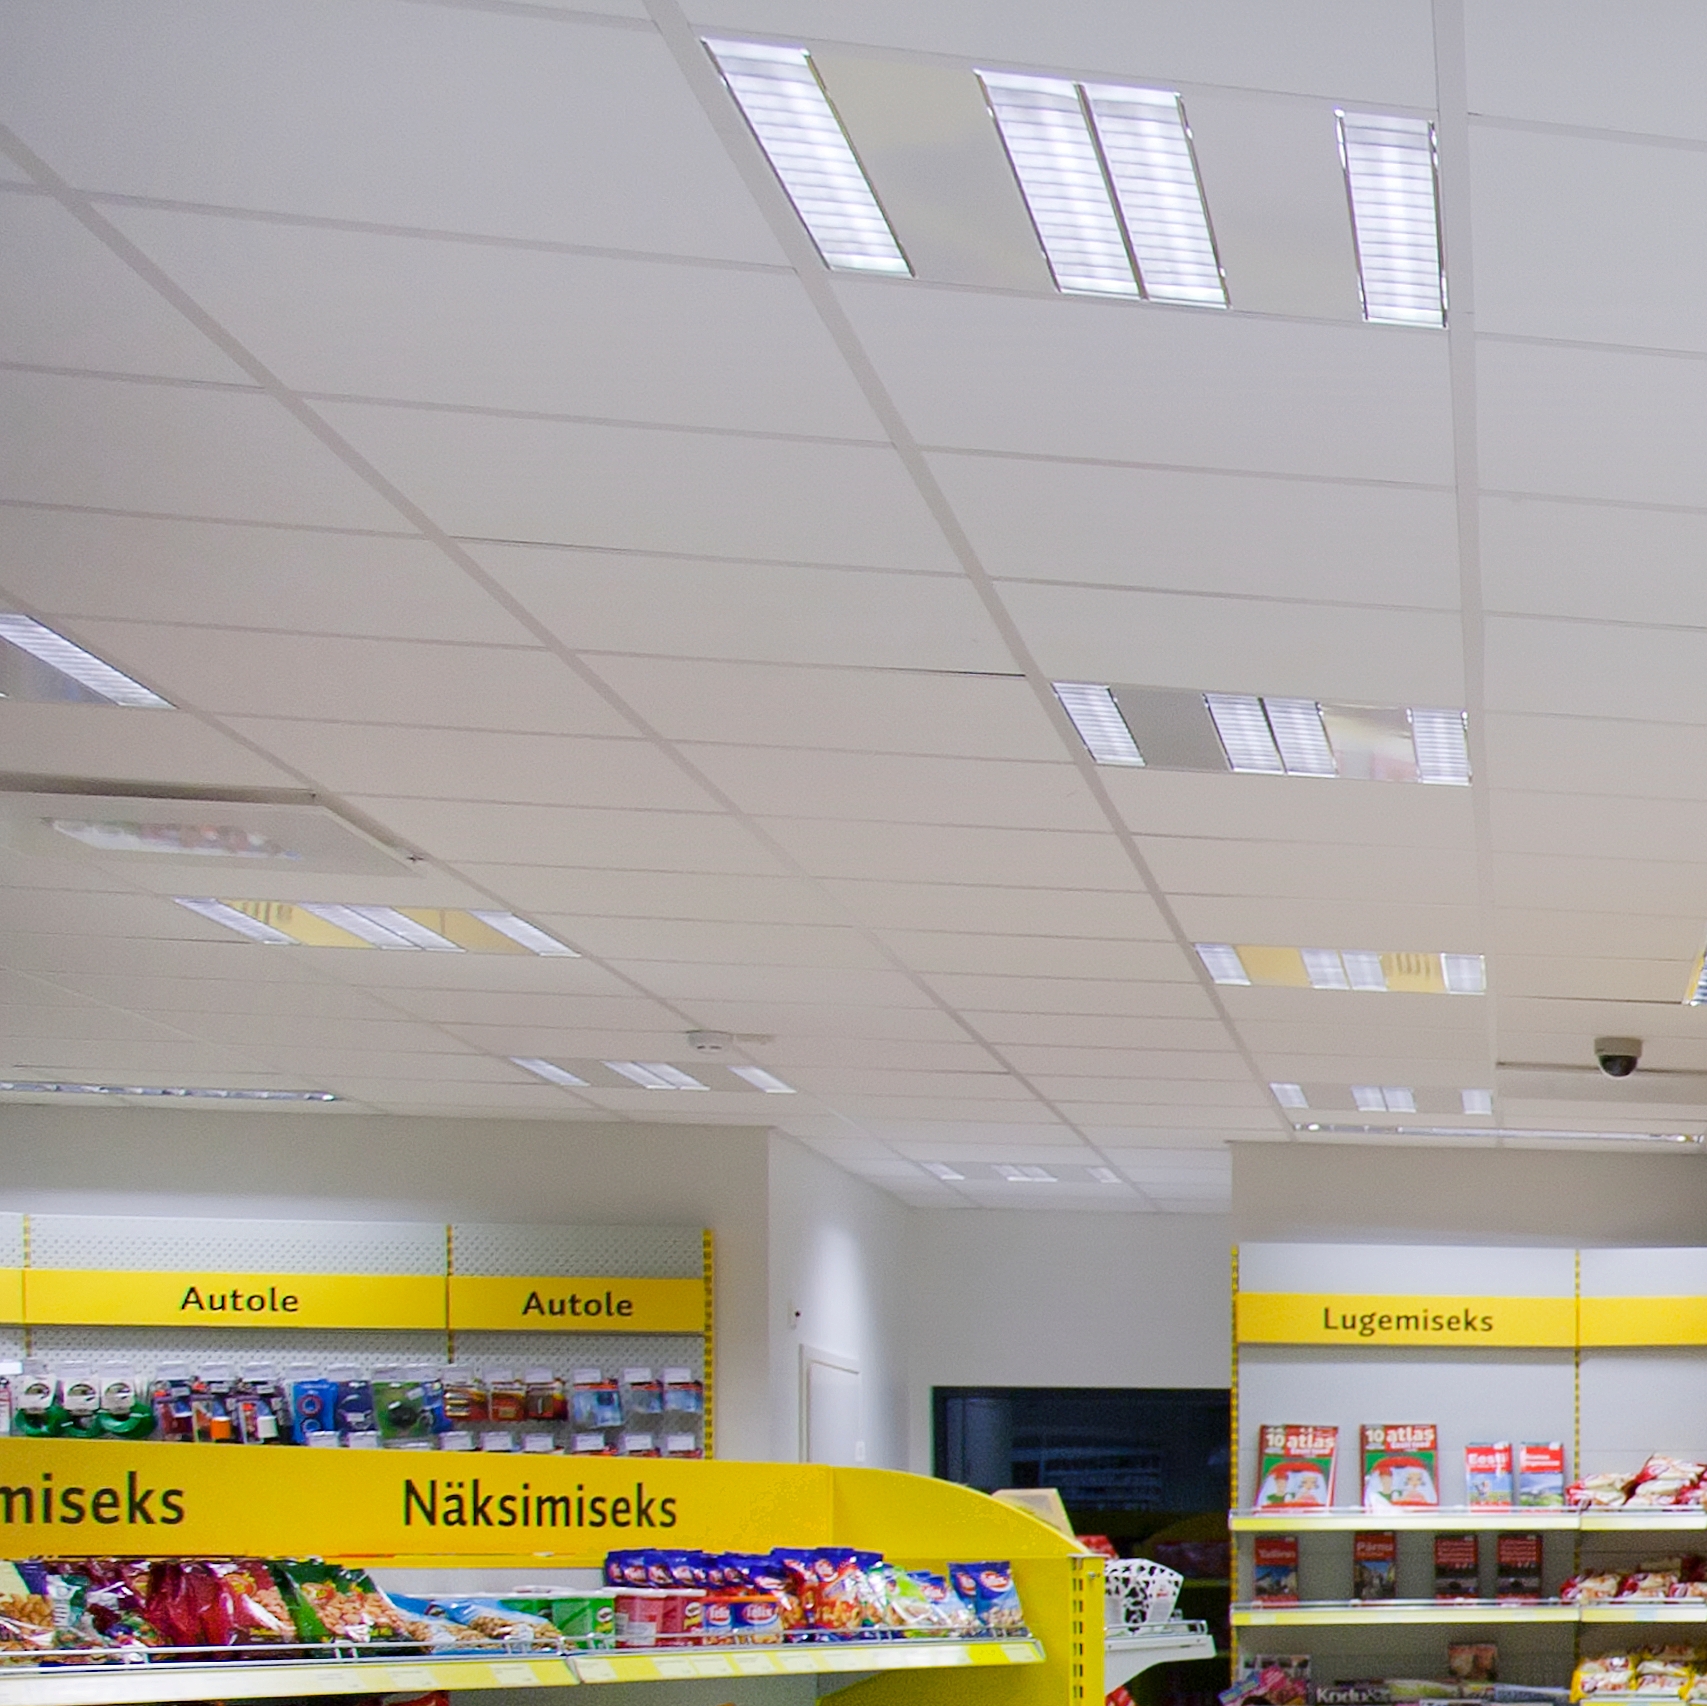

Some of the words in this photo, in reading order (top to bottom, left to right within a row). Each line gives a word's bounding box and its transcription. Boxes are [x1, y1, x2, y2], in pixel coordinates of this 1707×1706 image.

[180, 1285, 299, 1313] Autole
[522, 1290, 634, 1318] Autole
[1322, 1307, 1494, 1338] Lugemiseks
[1286, 1433, 1335, 1449] atlas
[1385, 1427, 1435, 1442] atlas
[0, 1472, 185, 1526] miseks
[403, 1478, 678, 1529] Näksimiseks
